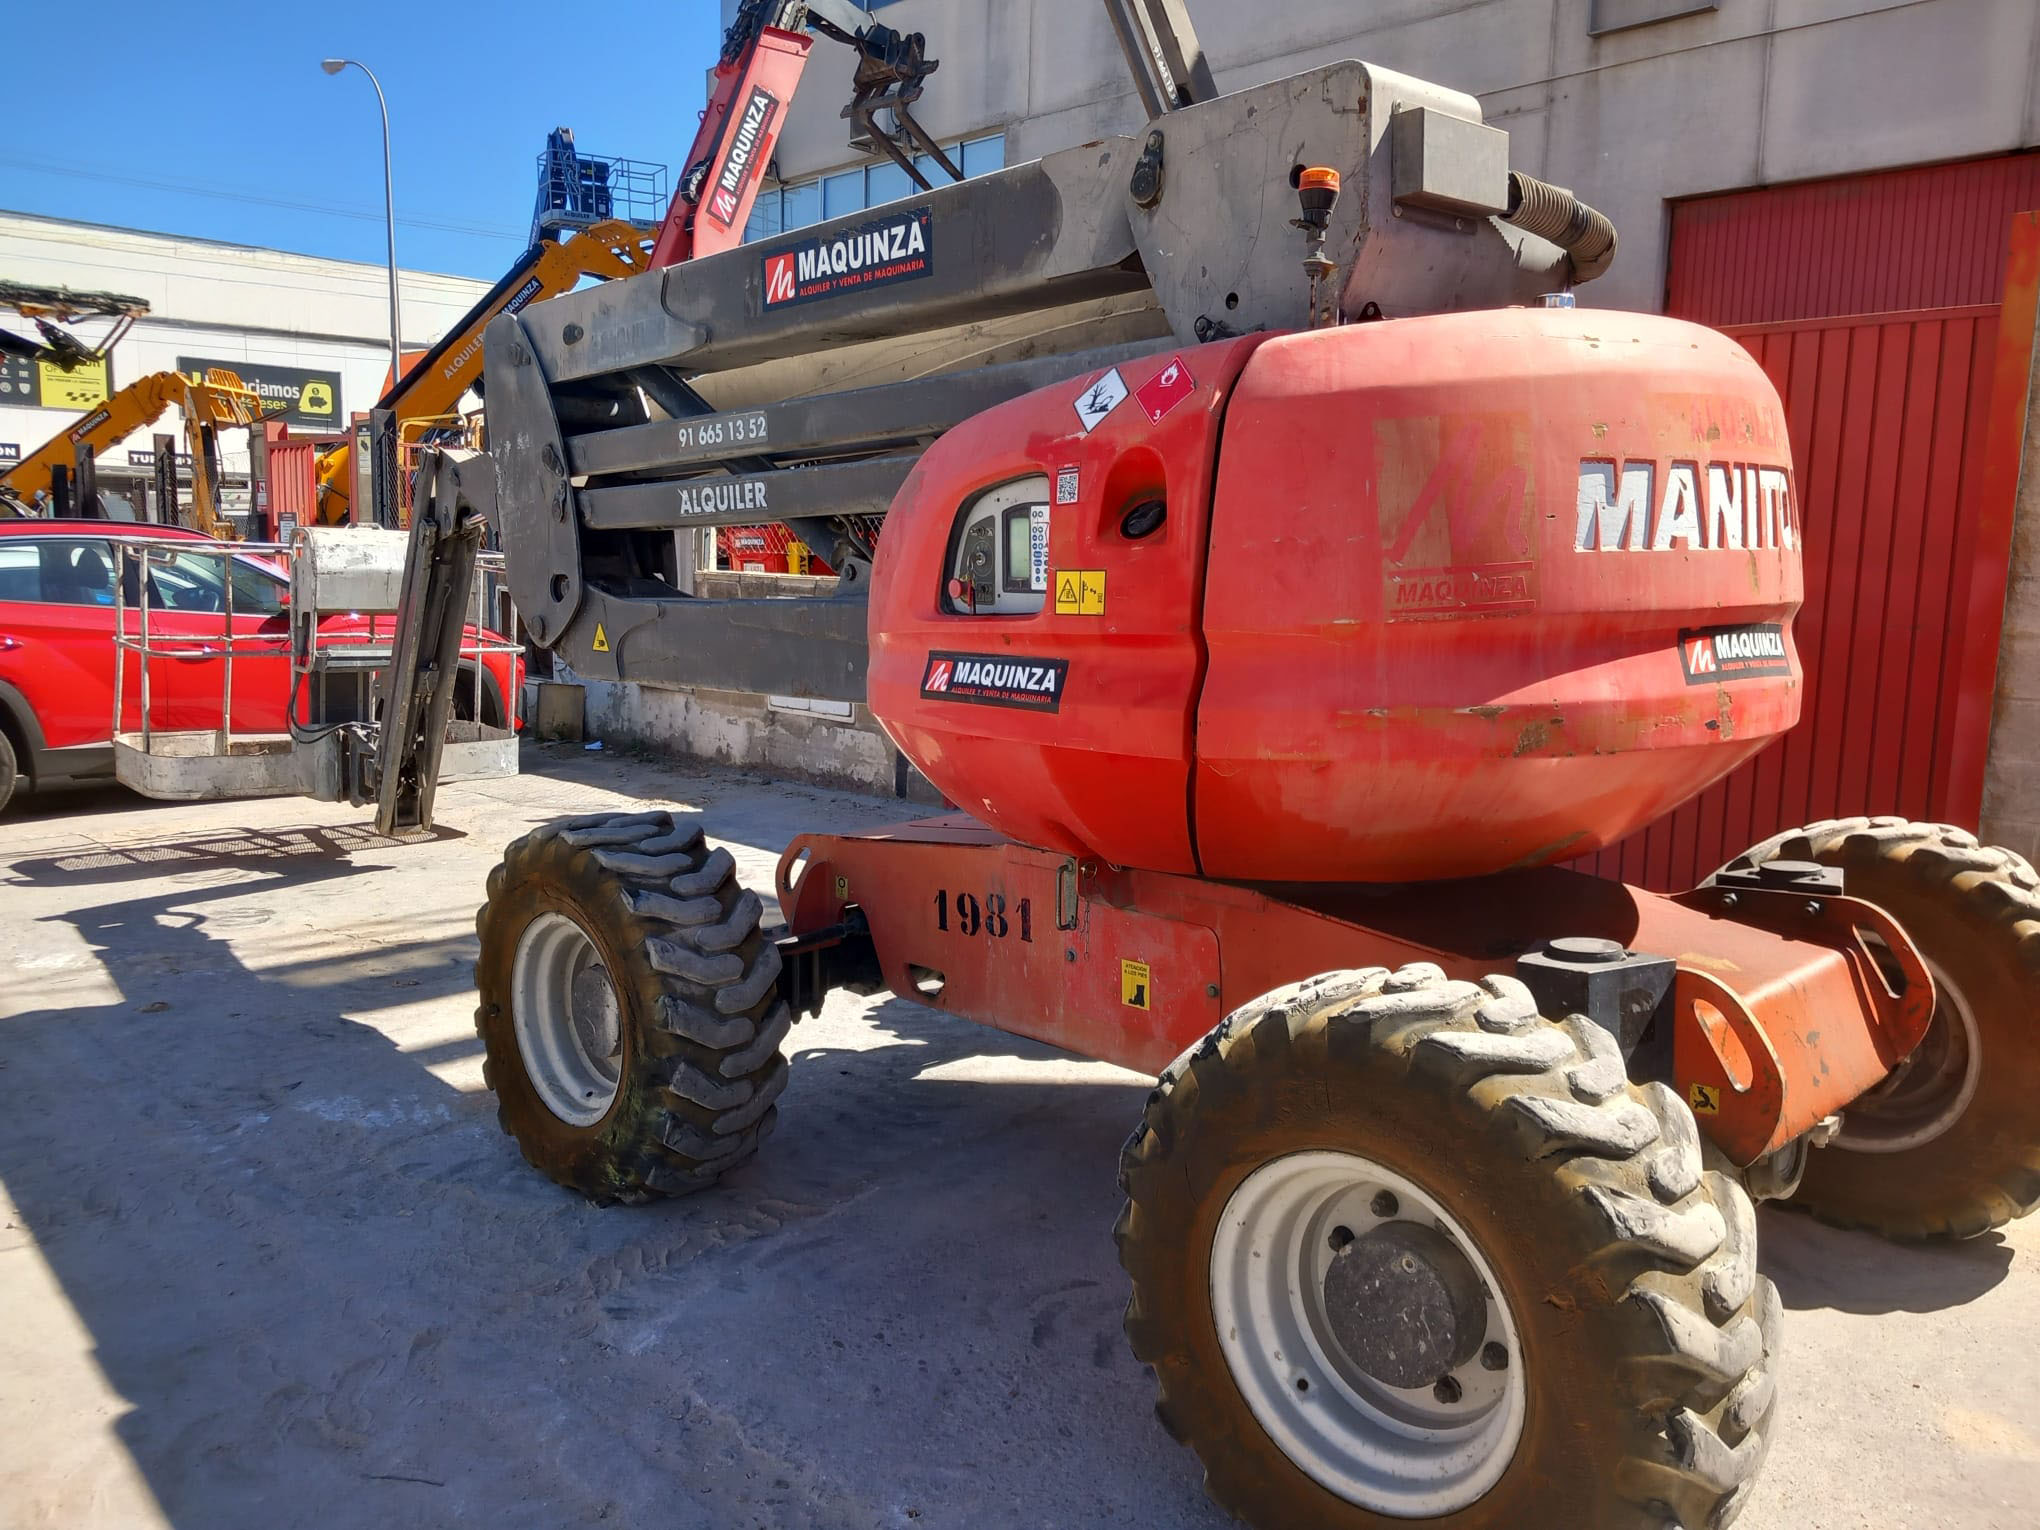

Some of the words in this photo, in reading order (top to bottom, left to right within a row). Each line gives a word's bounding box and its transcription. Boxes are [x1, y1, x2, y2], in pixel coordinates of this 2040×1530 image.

[721, 94, 769, 192] MAQUINZA
[798, 220, 925, 282] MAQUINZA
[799, 282, 830, 297] ALQUILER
[832, 281, 838, 289] Y
[839, 277, 862, 288] VENTA
[863, 273, 873, 282] DE
[874, 259, 925, 280] MAQUINARIA
[1153, 409, 1161, 420] 3
[679, 428, 694, 448] 91
[699, 423, 723, 446] 665
[728, 420, 745, 441] 13
[749, 416, 767, 439] 52
[680, 482, 768, 514] ALQUILER
[1574, 458, 1797, 552] MANITO
[1396, 574, 1527, 604] MAQUINZA
[1715, 632, 1785, 660] MAQUINZA
[953, 661, 1056, 693] MAQUINZA
[933, 889, 1033, 943] 1981
